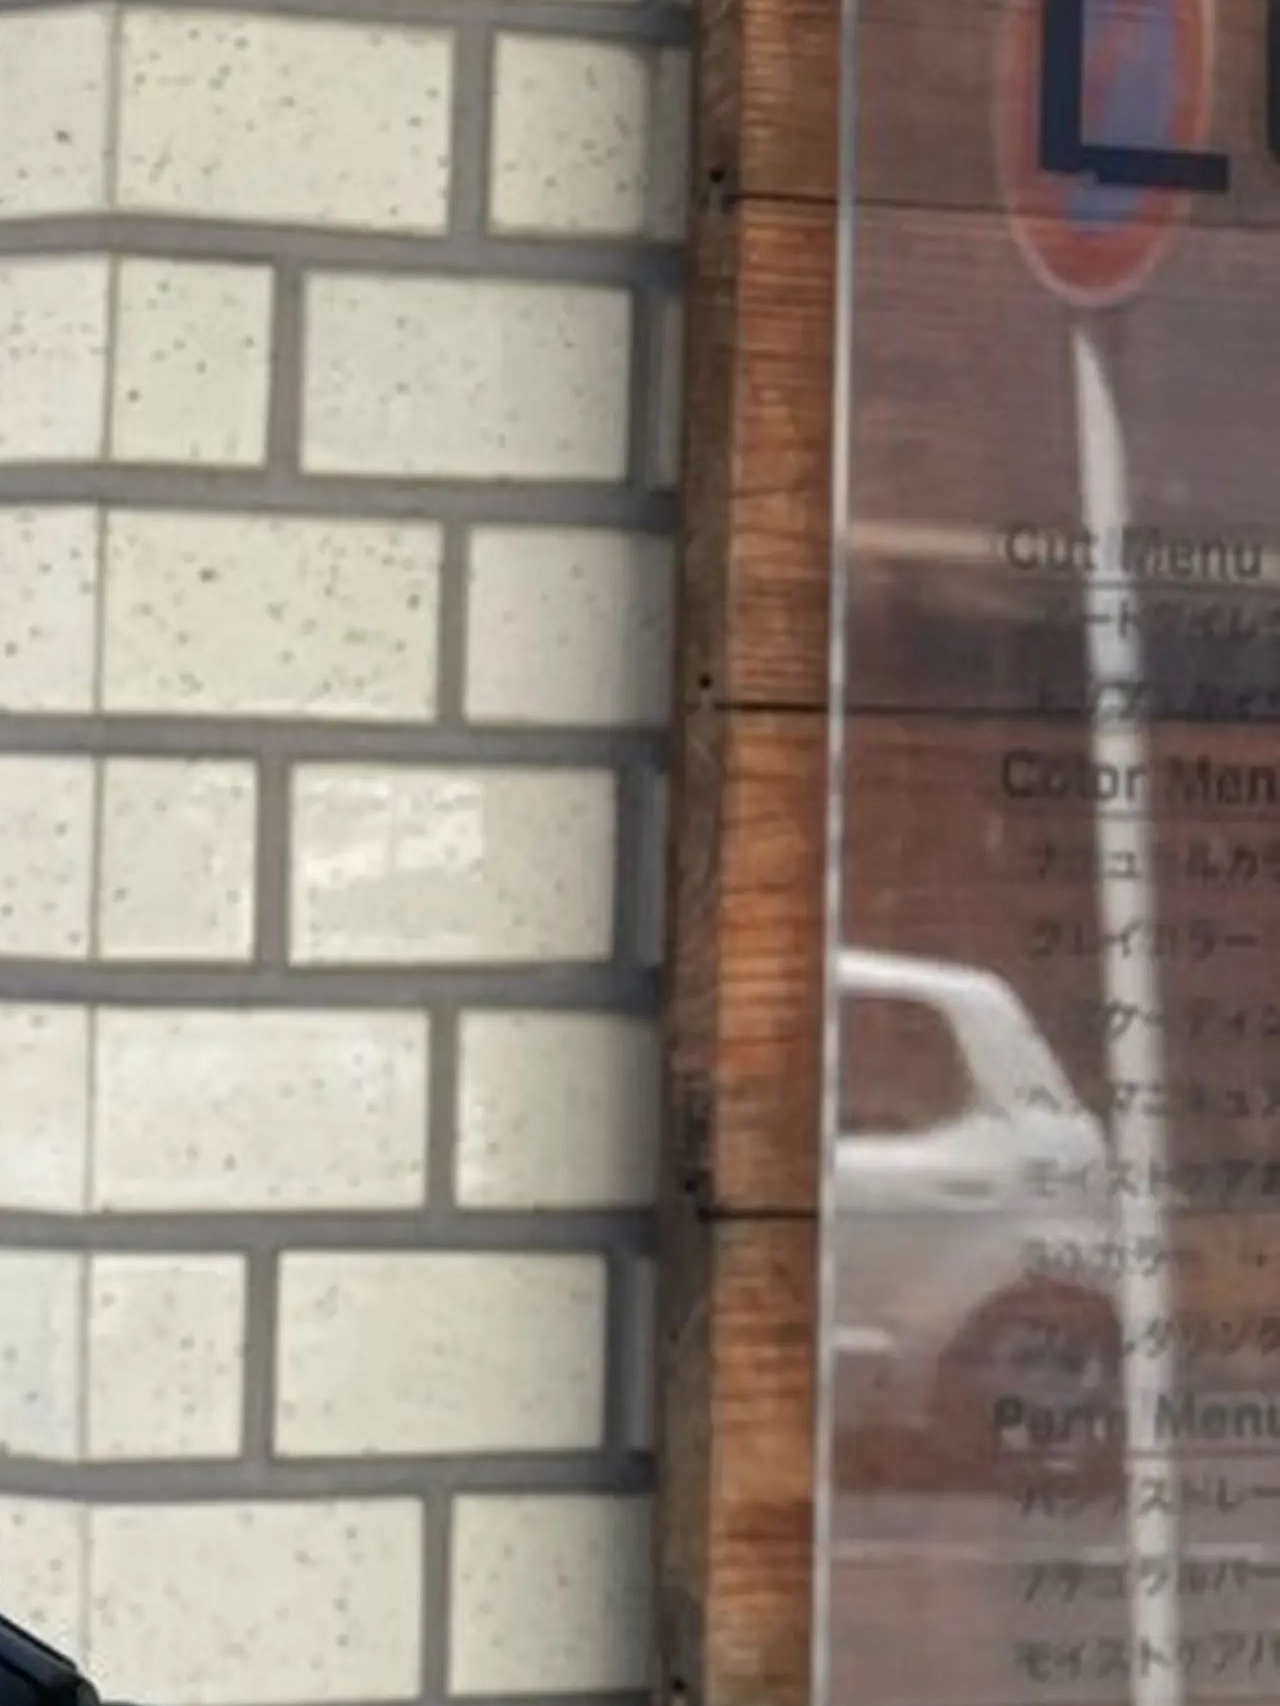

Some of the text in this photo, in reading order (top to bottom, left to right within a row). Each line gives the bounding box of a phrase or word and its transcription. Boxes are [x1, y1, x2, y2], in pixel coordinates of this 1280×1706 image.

[1003, 522, 1263, 577] Cut Menu
[1001, 749, 1144, 801] Color
